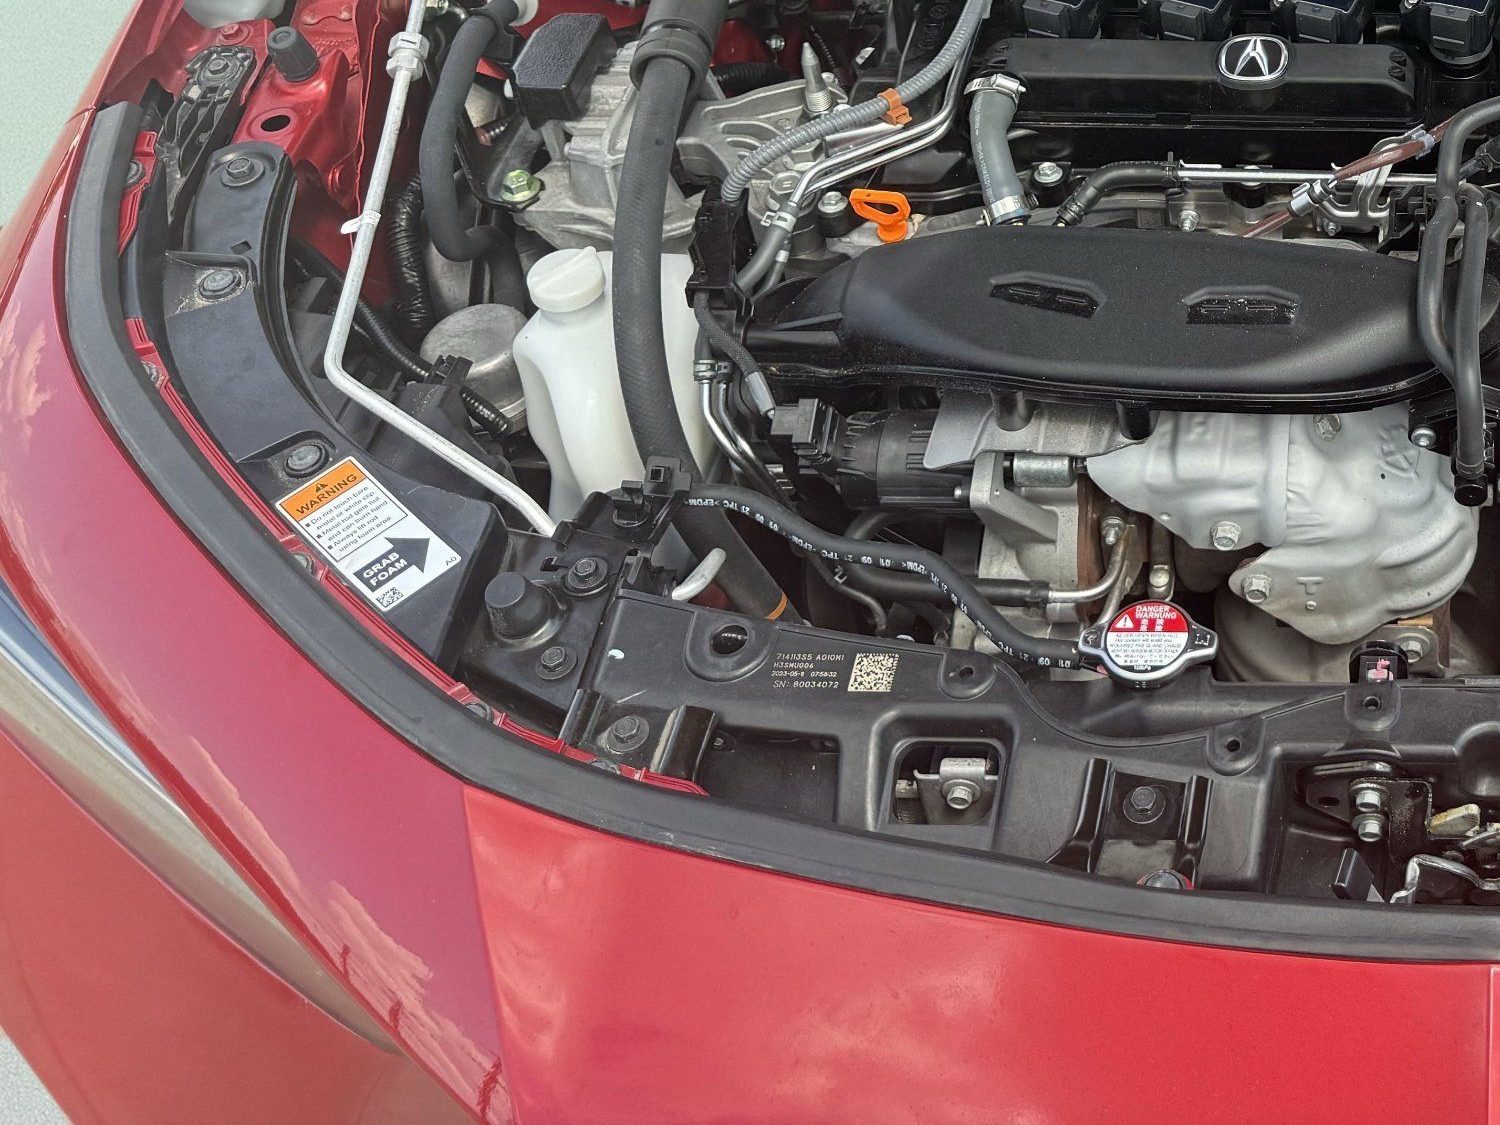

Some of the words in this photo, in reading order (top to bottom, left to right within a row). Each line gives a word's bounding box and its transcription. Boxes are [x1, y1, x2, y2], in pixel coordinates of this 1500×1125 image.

[295, 474, 357, 515] WARNING
[310, 516, 322, 525] Do
[322, 508, 334, 518] not
[333, 496, 353, 510] touch
[352, 486, 369, 498] bare
[722, 499, 739, 511] TPC
[316, 516, 336, 530] metal
[344, 499, 362, 512] white
[322, 521, 342, 536] Metal
[341, 513, 354, 523] rod
[354, 504, 369, 516] gets
[368, 496, 380, 505] hot
[328, 530, 341, 542] and
[342, 522, 355, 532] can
[354, 512, 371, 524] burn
[333, 530, 358, 546] Always
[357, 522, 367, 531] lift
[366, 515, 379, 525] rod
[338, 539, 359, 552] using
[357, 527, 376, 539] foam
[362, 551, 401, 579] GRAB
[821, 549, 839, 560] TPC
[369, 558, 408, 586] FOAM
[1135, 611, 1177, 619] WARNUNG
[998, 641, 1014, 656] TPC
[772, 680, 790, 688] SN:
